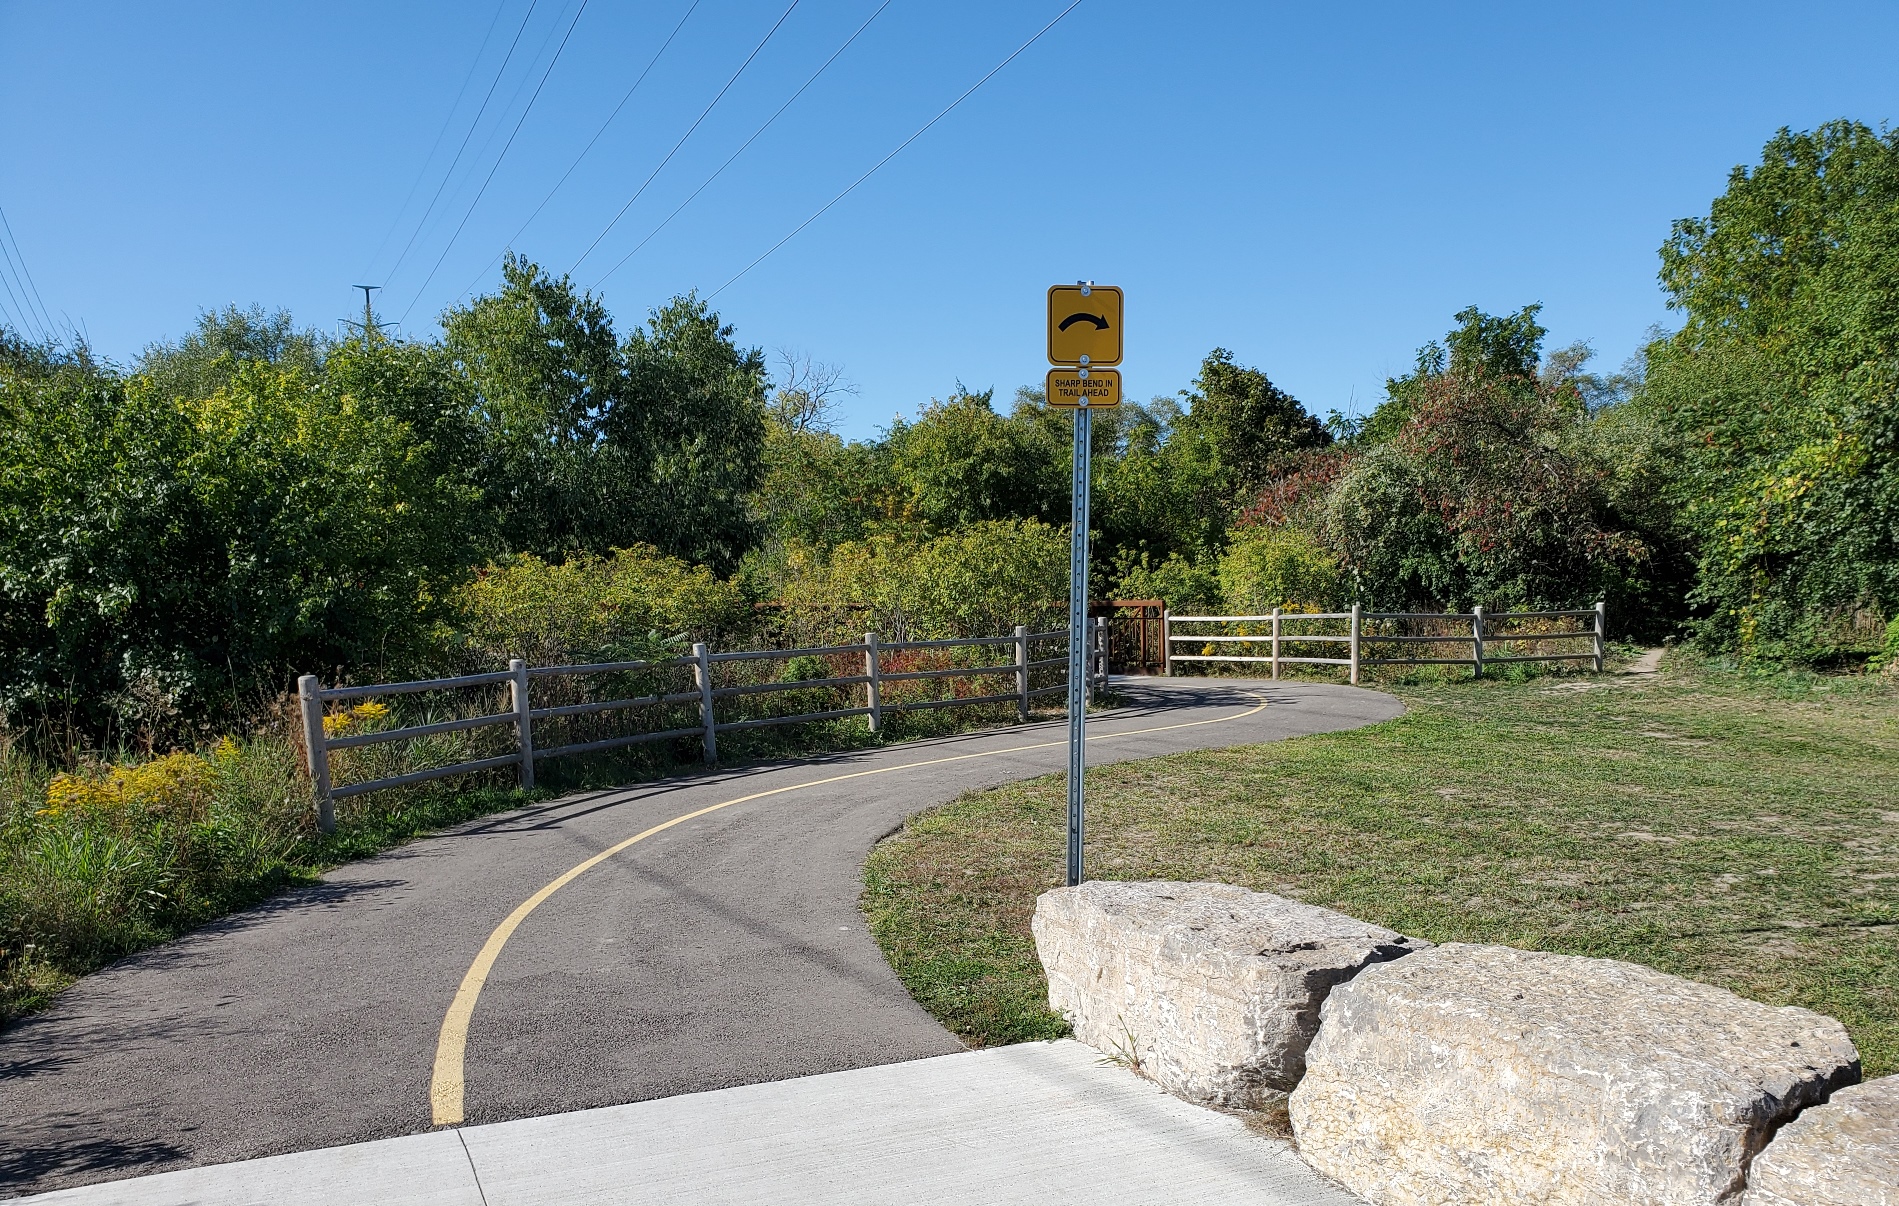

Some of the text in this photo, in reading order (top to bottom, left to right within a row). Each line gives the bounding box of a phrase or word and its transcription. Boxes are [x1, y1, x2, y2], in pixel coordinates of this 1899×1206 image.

[1055, 379, 1113, 388] SHARP BEND IN
[1058, 388, 1109, 397] TRAIL AHEAD
